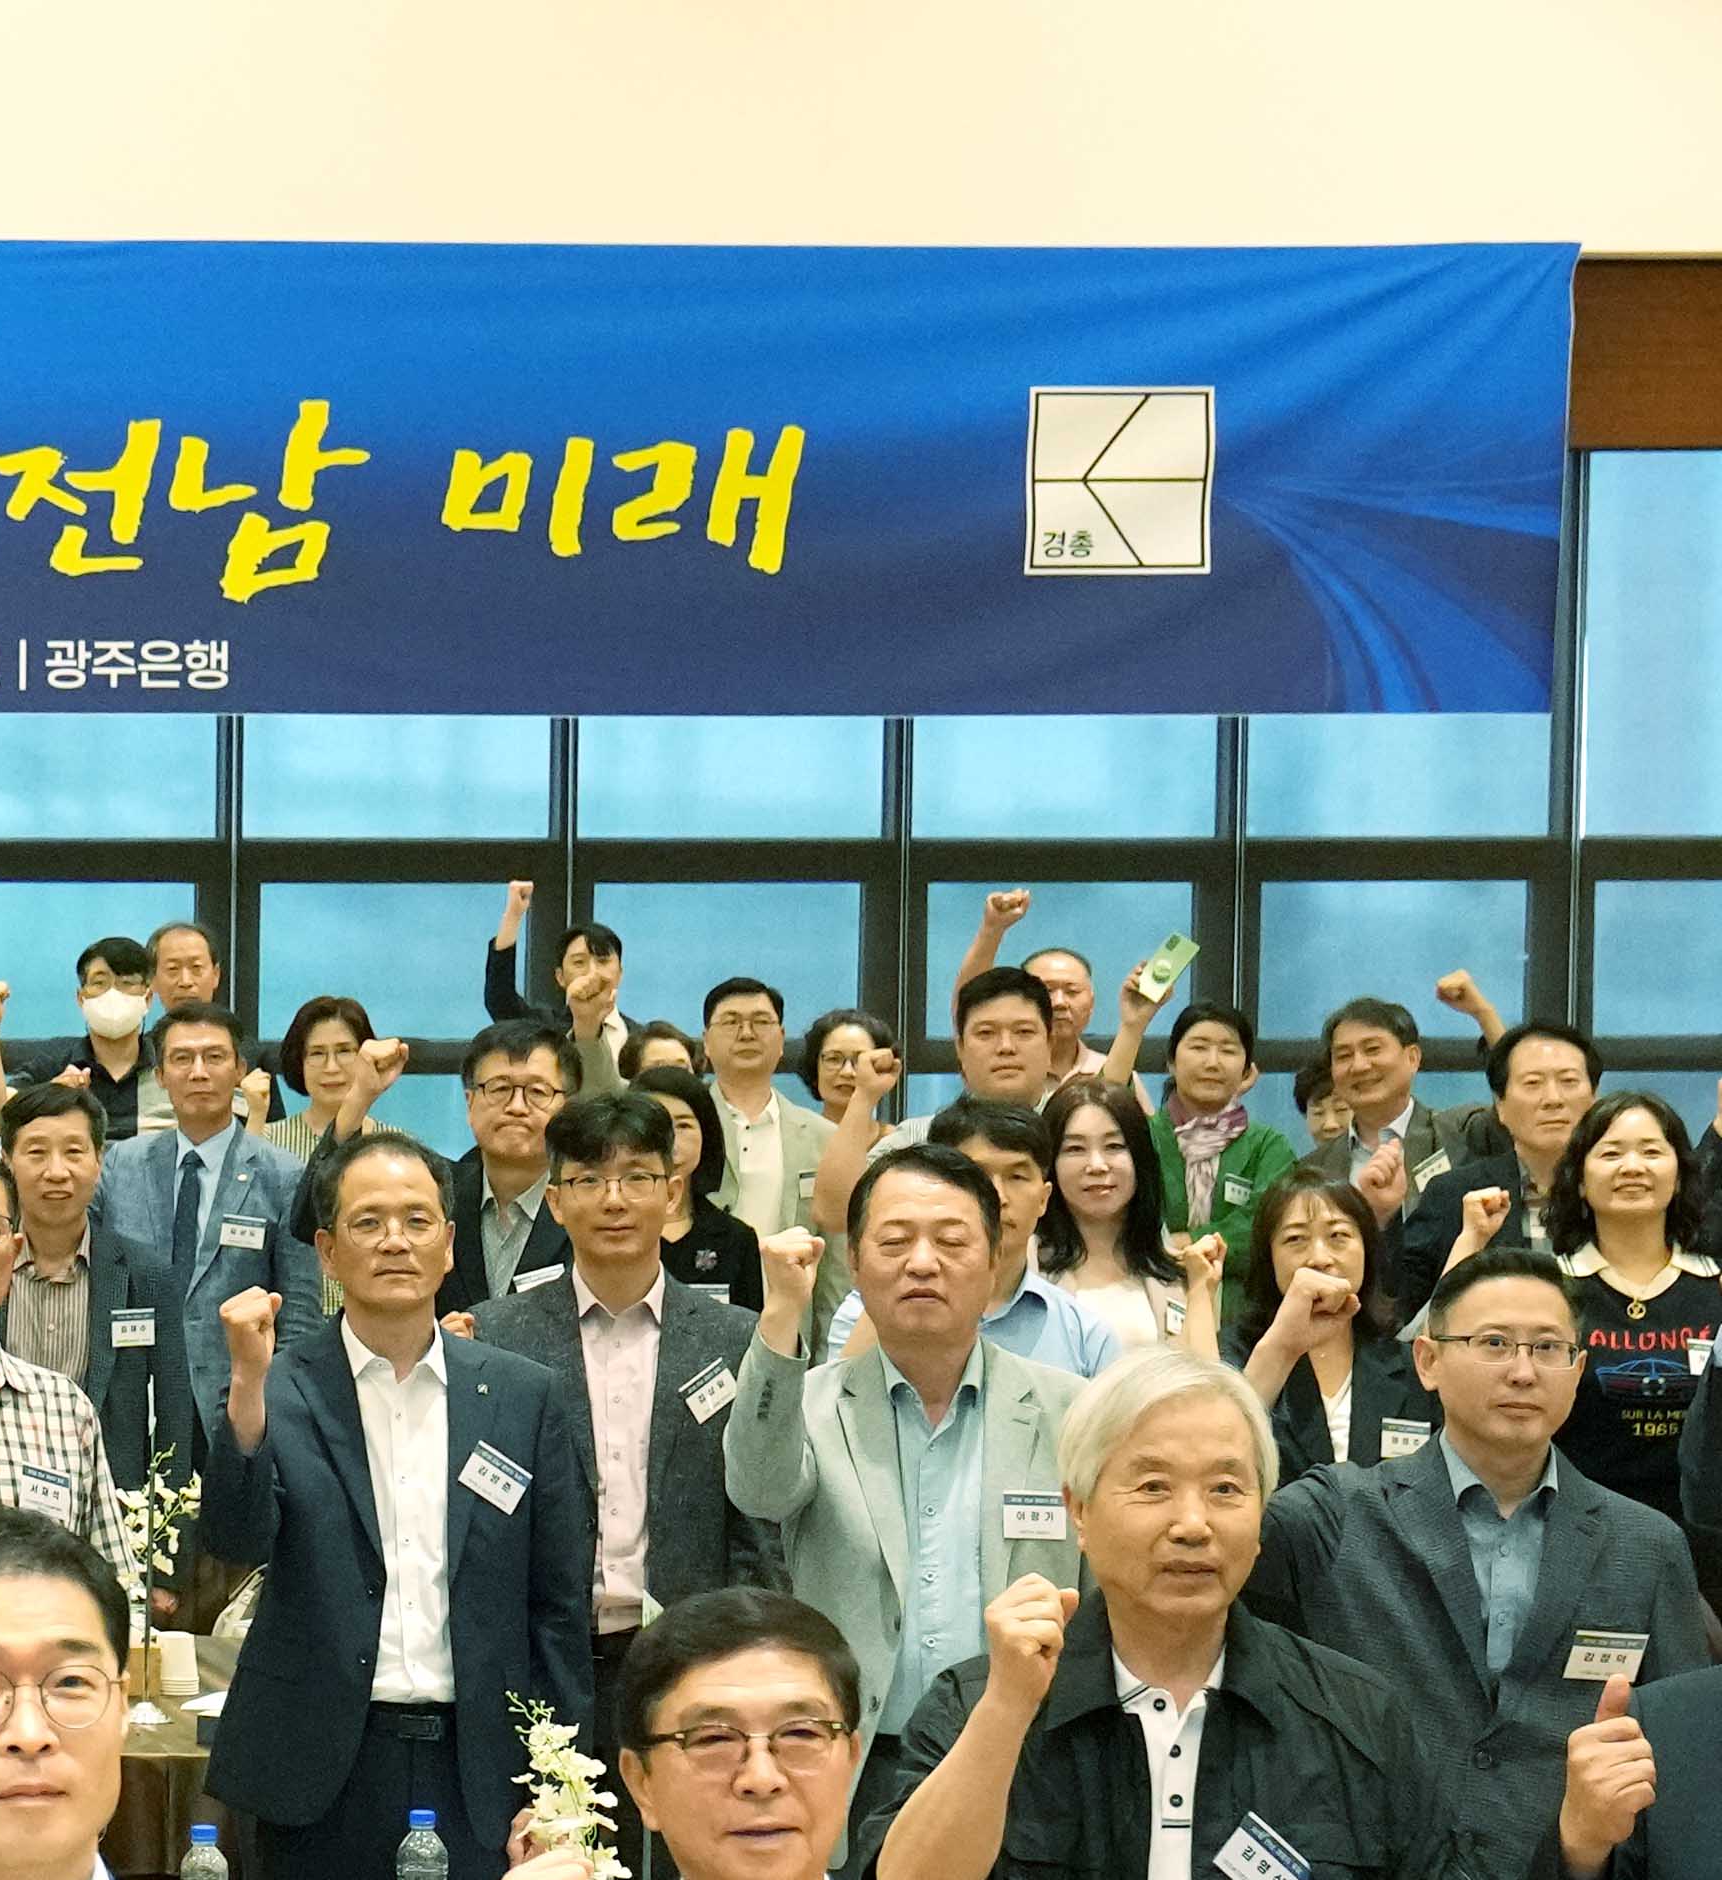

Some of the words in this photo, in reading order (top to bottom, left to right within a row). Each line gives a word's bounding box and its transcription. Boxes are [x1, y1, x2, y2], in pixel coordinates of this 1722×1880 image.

[442, 426, 806, 576] 미래
[1042, 529, 1095, 559] 경총
[46, 640, 230, 691] 광주은행
